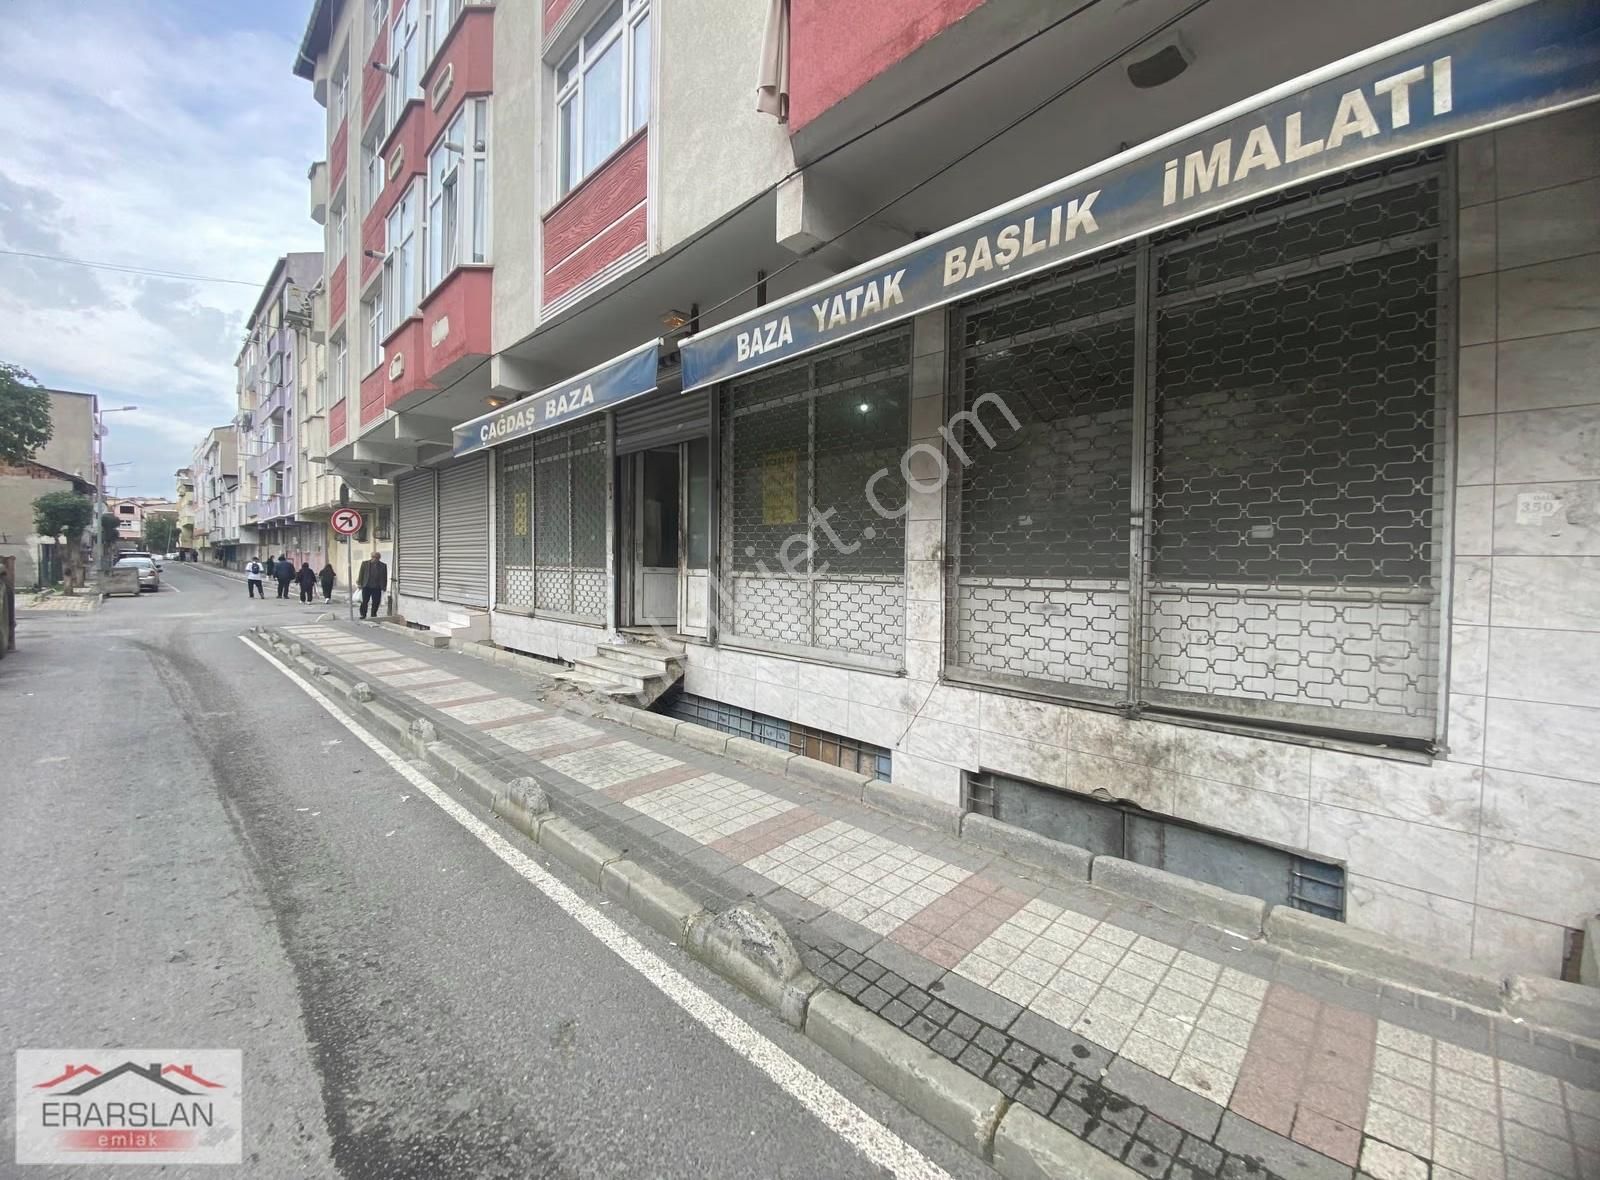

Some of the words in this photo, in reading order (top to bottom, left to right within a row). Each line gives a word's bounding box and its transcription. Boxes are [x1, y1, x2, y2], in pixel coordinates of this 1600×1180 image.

[736, 315, 794, 362] BAZA
[812, 268, 906, 333] YATAK
[943, 189, 1102, 287] BAŞLIK
[1162, 55, 1453, 208] İMALATI
[480, 406, 535, 446] ÇAĞDAŞ
[544, 383, 595, 420] BAZA
[1520, 501, 1553, 513] 350
